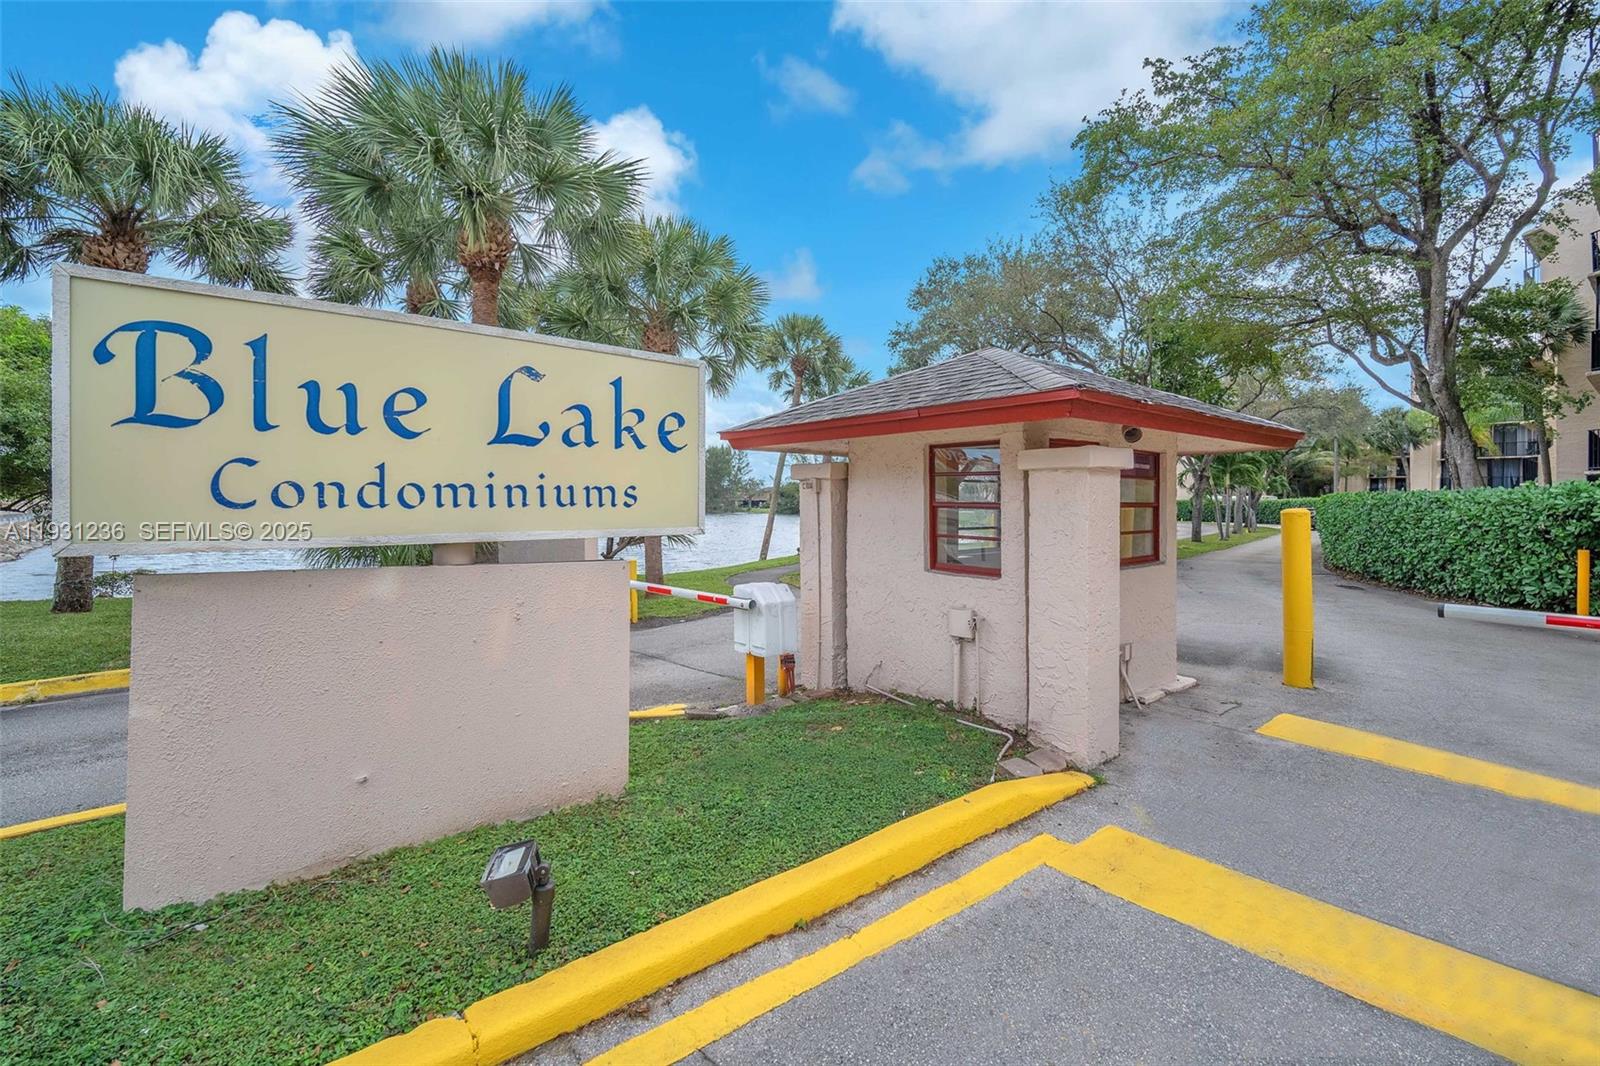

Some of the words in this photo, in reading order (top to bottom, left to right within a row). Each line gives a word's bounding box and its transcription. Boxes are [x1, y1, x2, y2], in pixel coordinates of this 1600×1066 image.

[92, 319, 429, 440] Blue
[486, 364, 688, 455] Lake
[209, 456, 638, 510] Condominiums
